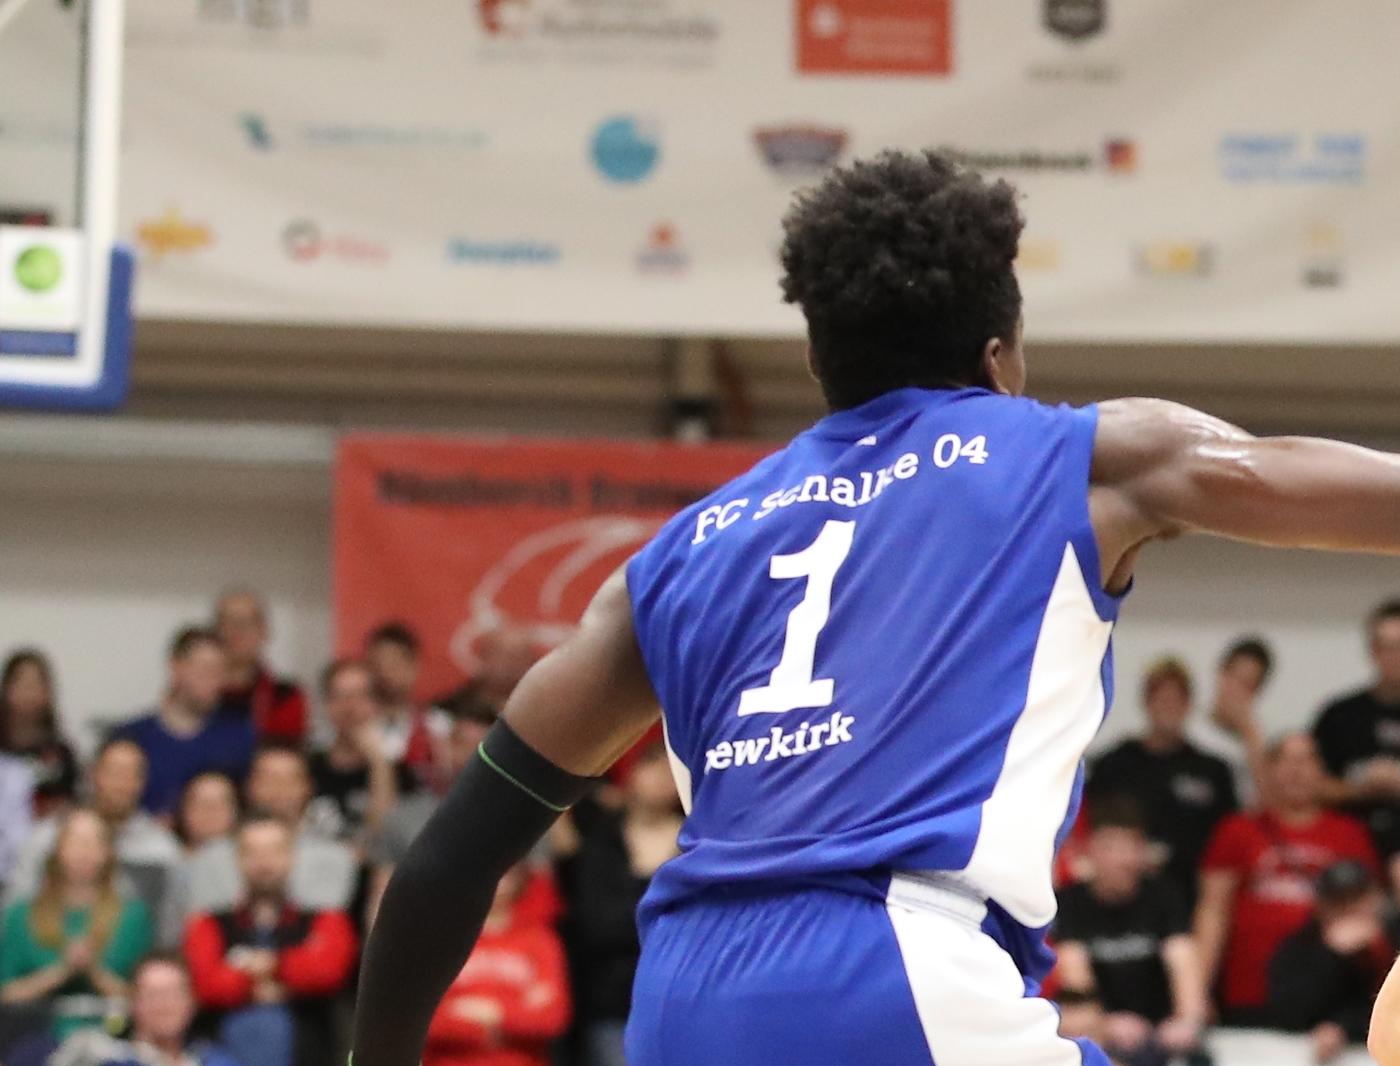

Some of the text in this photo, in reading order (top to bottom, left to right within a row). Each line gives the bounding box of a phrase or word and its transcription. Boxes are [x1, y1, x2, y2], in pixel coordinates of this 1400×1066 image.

[691, 499, 749, 545] FC
[932, 433, 989, 469] 04
[737, 519, 856, 717] 1
